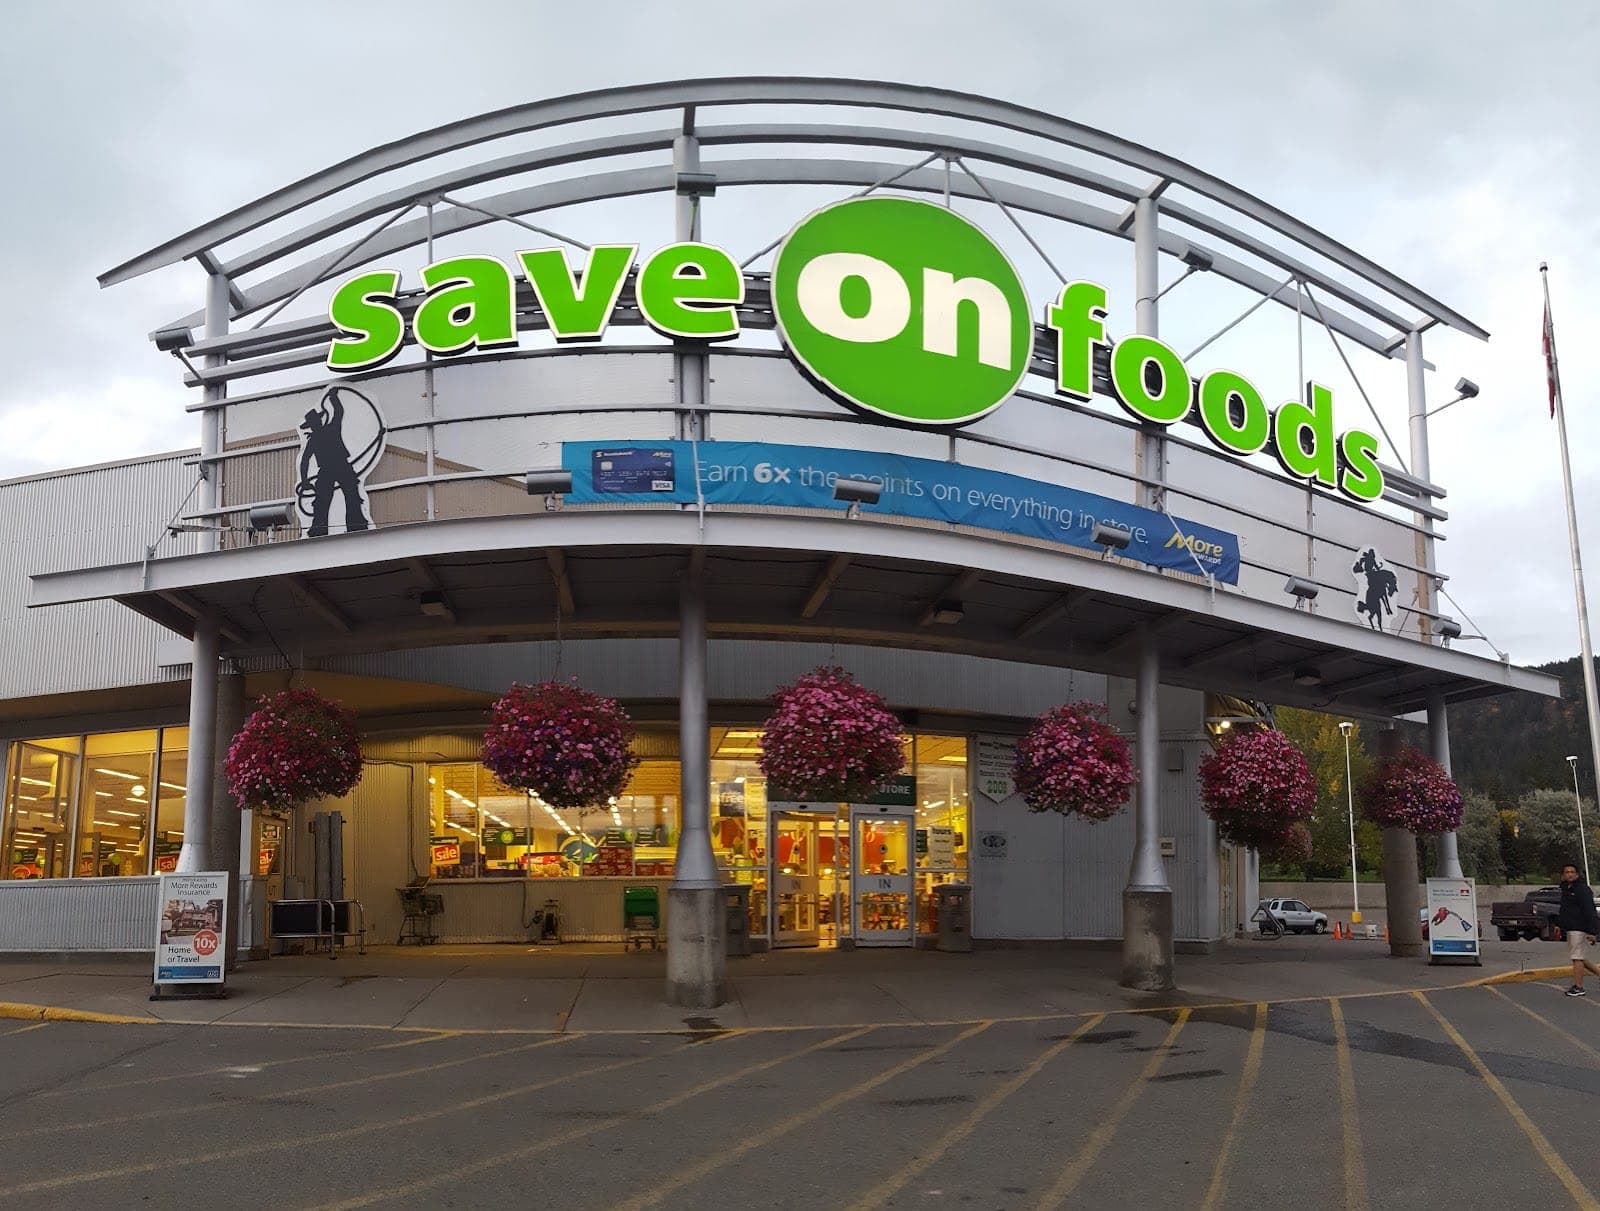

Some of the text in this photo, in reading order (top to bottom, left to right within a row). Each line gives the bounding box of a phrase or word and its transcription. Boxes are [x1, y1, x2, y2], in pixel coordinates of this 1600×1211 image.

[327, 242, 1386, 503] save on foods
[698, 460, 747, 483] Earn
[753, 462, 791, 484] 6x
[798, 465, 840, 488] the
[849, 472, 924, 497] oints
[932, 482, 961, 502] on
[967, 488, 1074, 530] everything
[1079, 509, 1096, 530] in
[1163, 531, 1223, 557] More
[1189, 551, 1222, 565] RWARDS
[436, 847, 457, 861] sale
[80, 861, 94, 872] ale
[161, 857, 176, 870] sal
[878, 878, 892, 889] IN
[194, 937, 216, 949] 10x
[167, 946, 191, 954] Home
[176, 955, 200, 963] Travel
